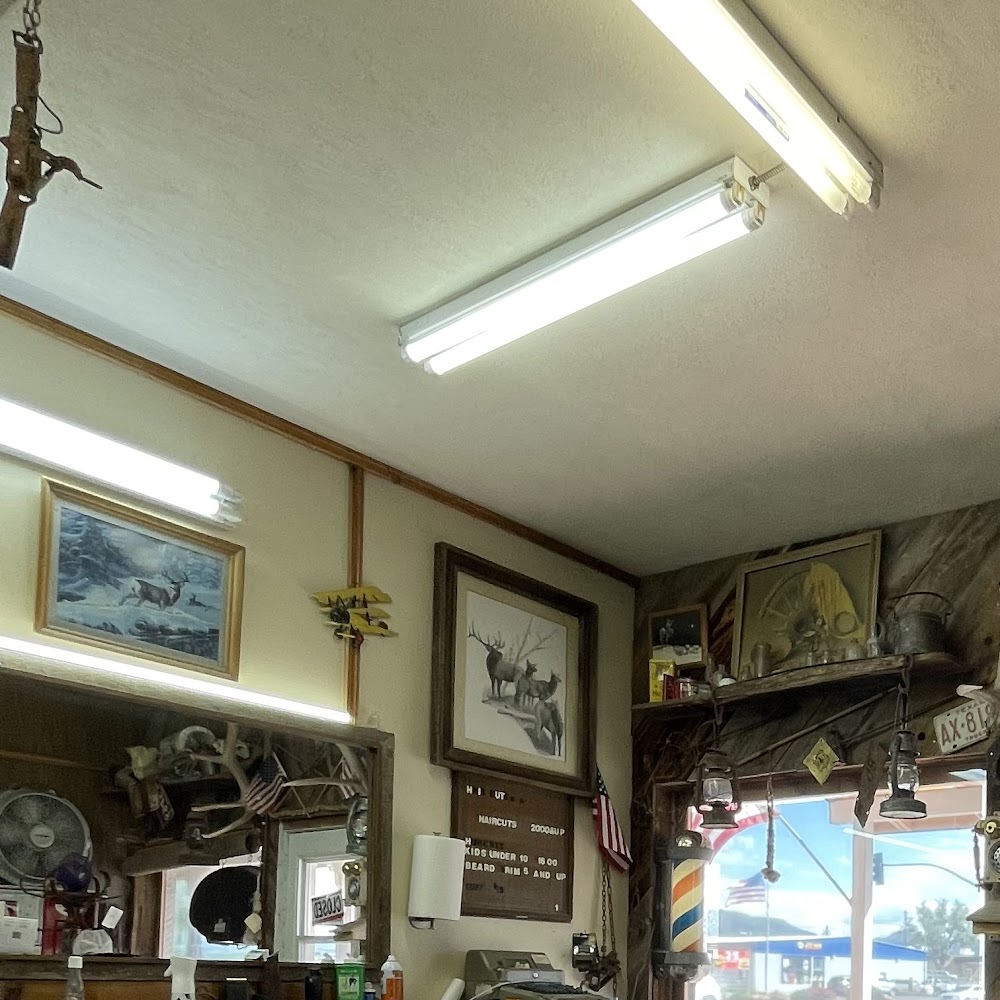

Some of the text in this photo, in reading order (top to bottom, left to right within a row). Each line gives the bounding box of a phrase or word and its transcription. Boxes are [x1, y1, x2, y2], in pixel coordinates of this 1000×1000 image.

[478, 815, 518, 829] HAIRCUTS
[465, 847, 487, 857] KIDS
[489, 850, 517, 861] UNDER
[520, 854, 529, 863] 10
[465, 861, 496, 873] BEARD
[533, 870, 551, 880] AND
[556, 872, 567, 880] UP
